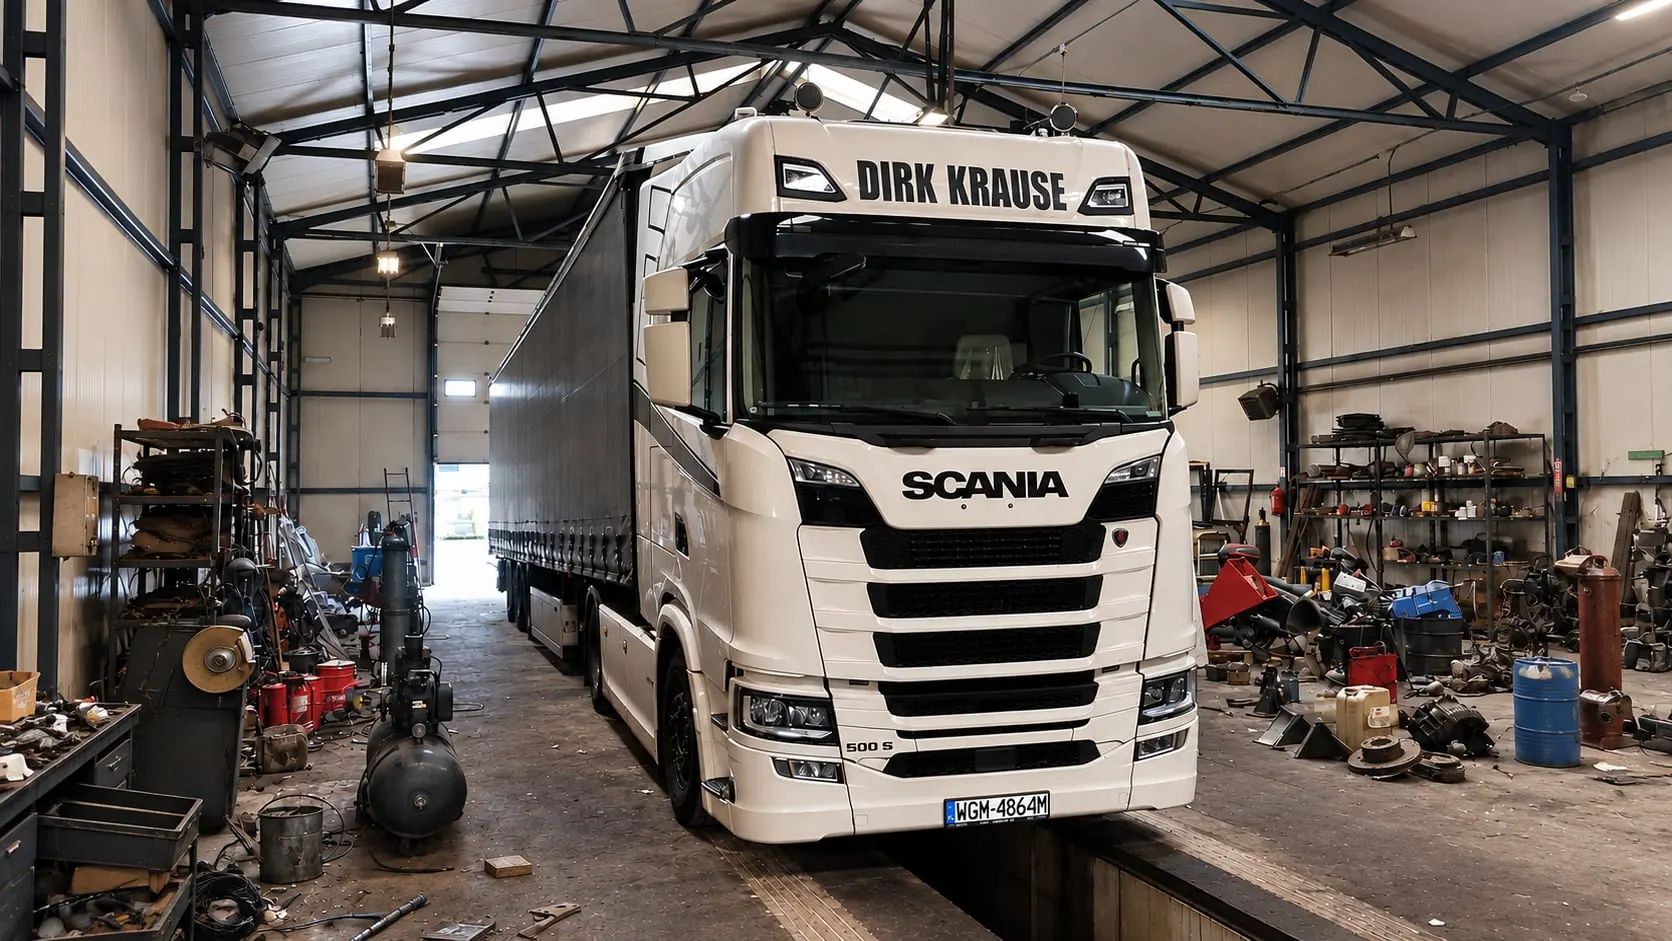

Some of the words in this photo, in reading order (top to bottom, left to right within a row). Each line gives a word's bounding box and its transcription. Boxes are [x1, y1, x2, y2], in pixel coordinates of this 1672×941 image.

[857, 160, 938, 204] DIRK
[947, 165, 1067, 211] KRAUSE
[902, 471, 1069, 500] SCANIA
[846, 742, 878, 752] 500
[882, 741, 893, 750] S
